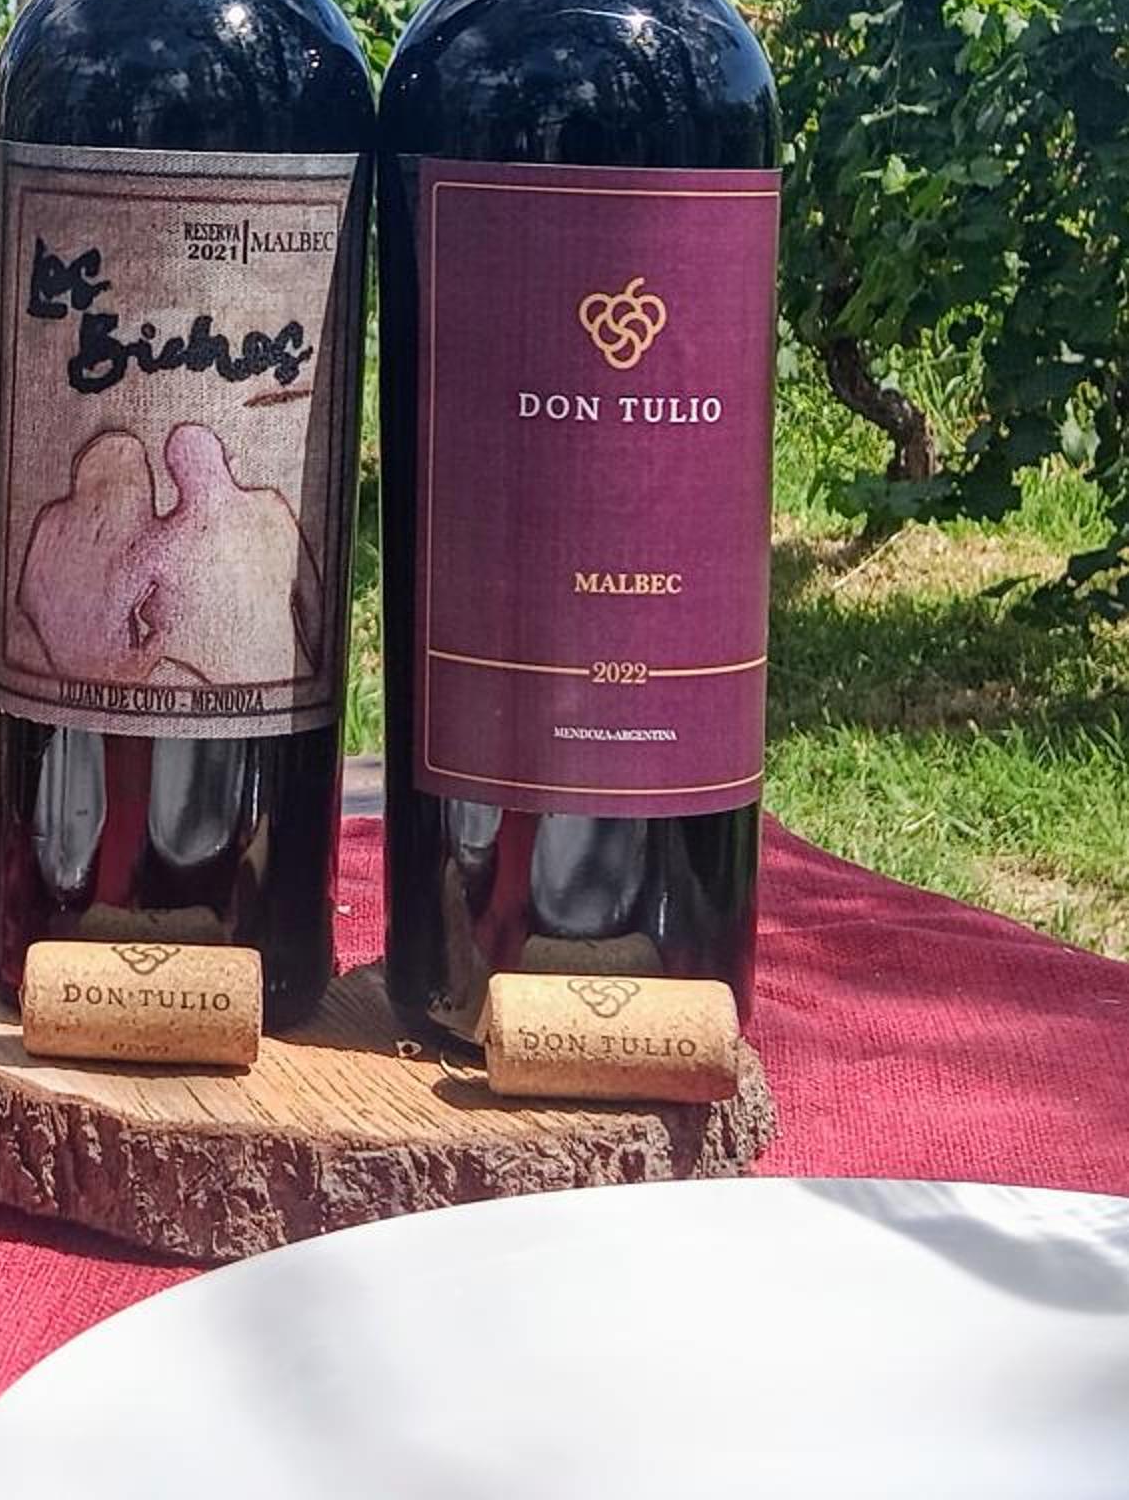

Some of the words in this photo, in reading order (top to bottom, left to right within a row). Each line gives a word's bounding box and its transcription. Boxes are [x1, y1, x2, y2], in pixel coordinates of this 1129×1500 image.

[184, 221, 241, 243] RESERVA
[250, 231, 335, 253] MALBEC
[188, 243, 238, 261] 2021
[518, 392, 600, 421] DON
[619, 397, 722, 423] TULIO
[574, 572, 683, 595] MALBEC
[592, 661, 648, 684] 2022
[107, 685, 129, 708] DE
[133, 687, 176, 711] CUYO
[191, 689, 265, 713] MENDOZA
[62, 983, 125, 1007] DON
[138, 988, 231, 1012] TULIO
[522, 1031, 587, 1052] DON
[601, 1034, 697, 1057] TULIO
